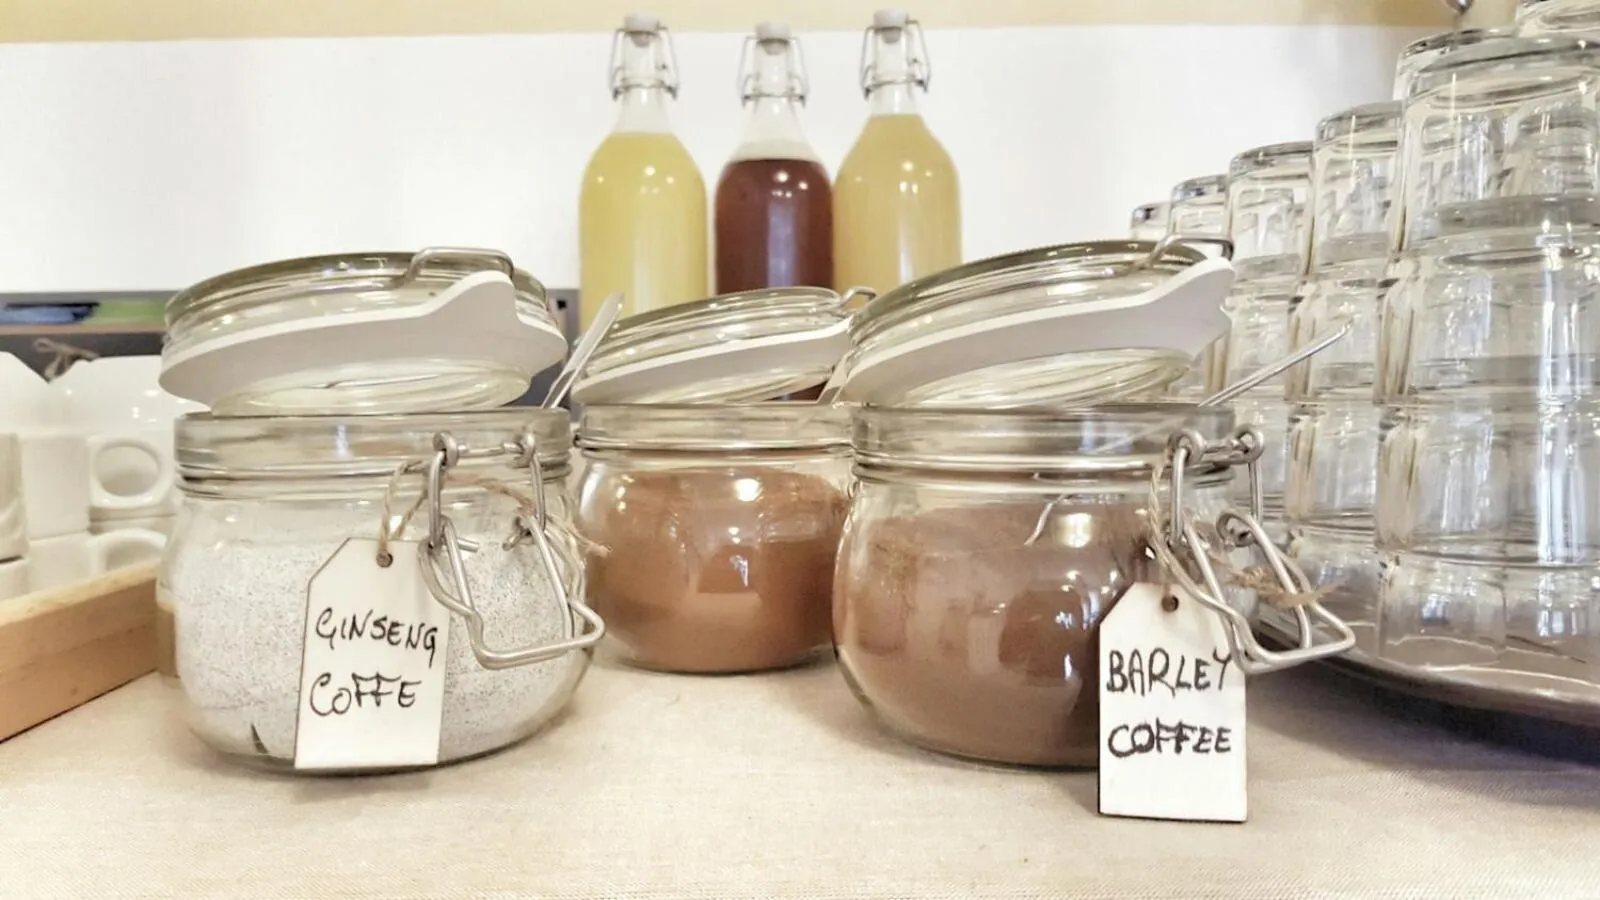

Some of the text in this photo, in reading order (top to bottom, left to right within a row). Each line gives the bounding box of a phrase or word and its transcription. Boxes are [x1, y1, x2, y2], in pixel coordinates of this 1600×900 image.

[315, 607, 438, 668] GINSENG
[1106, 647, 1232, 699] BARLEY
[1108, 717, 1232, 758] COFFEE
